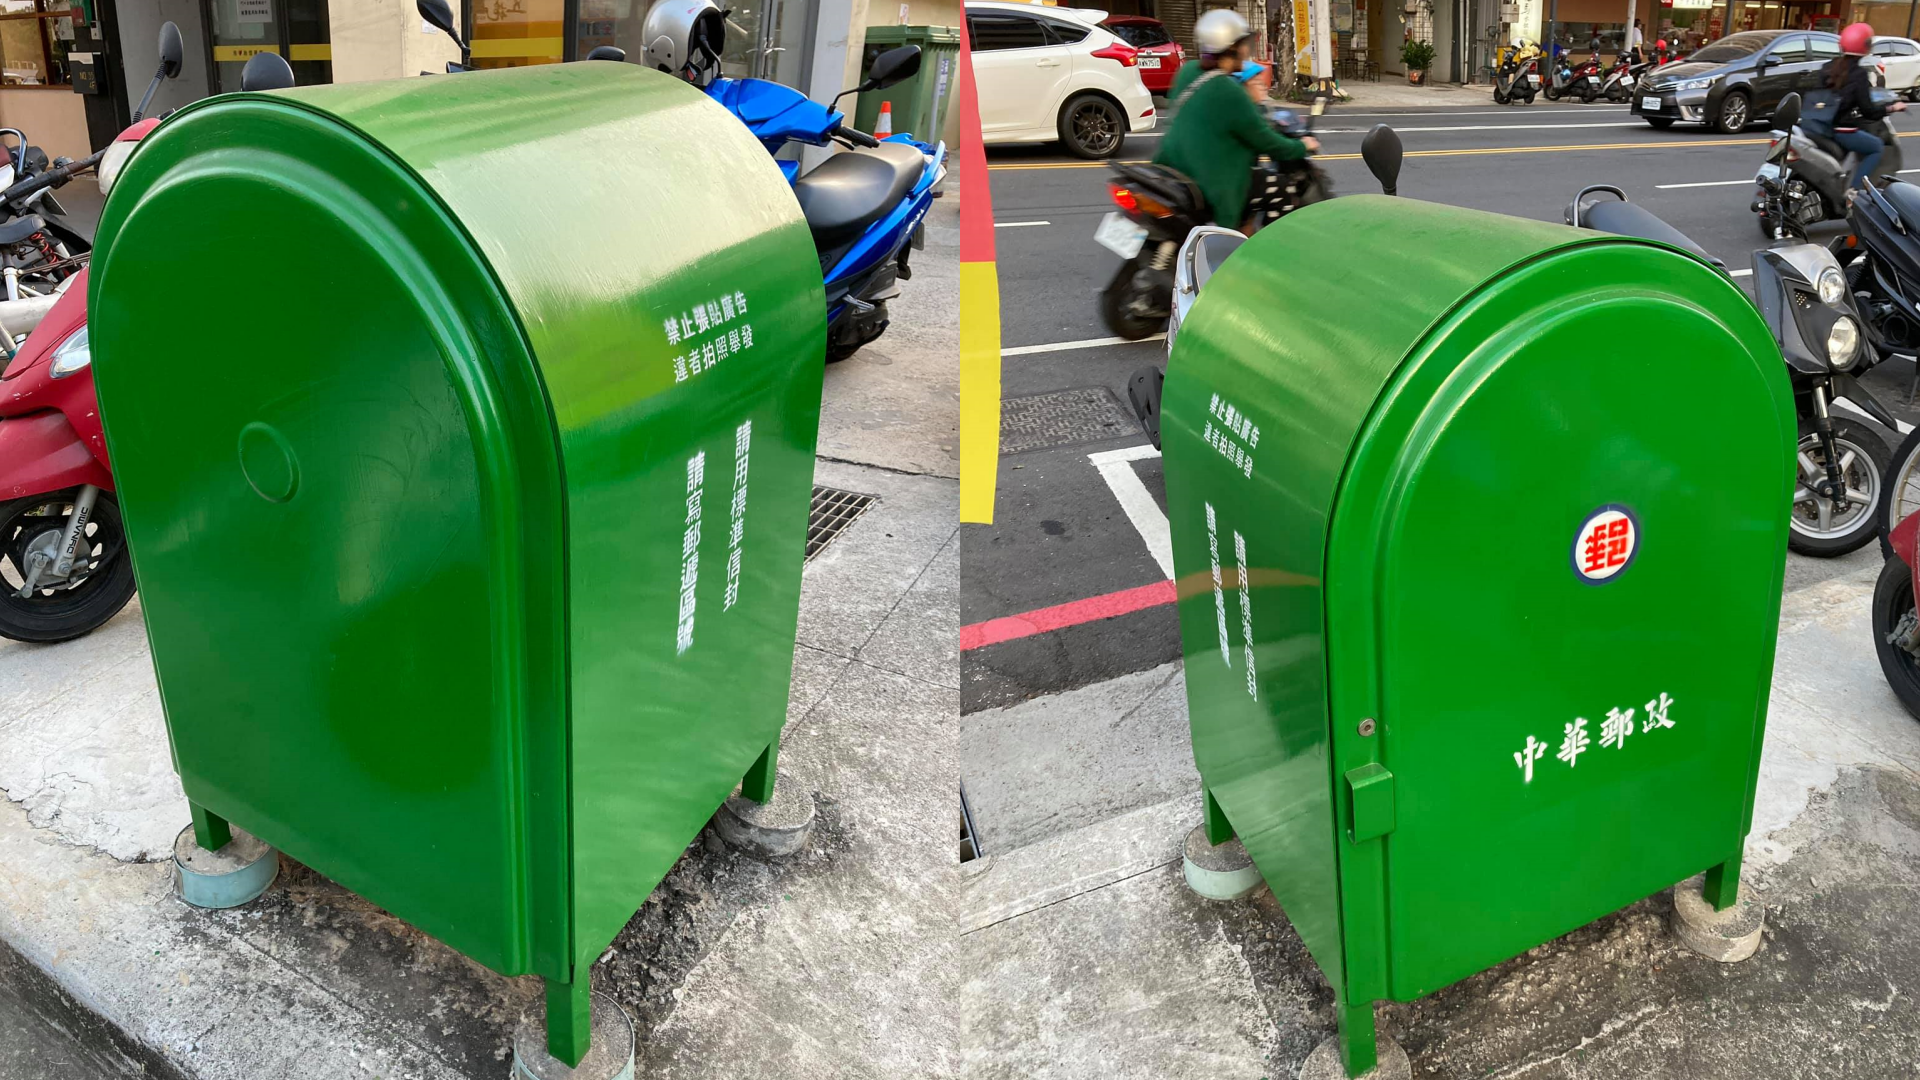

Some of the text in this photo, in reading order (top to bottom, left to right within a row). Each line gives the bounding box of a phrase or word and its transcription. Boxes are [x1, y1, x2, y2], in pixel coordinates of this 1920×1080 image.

[663, 290, 748, 346] 禁止張貼廣告
[672, 323, 754, 384] 違者拍照舉發
[1208, 392, 1260, 450] 禁止張貼廣告
[67, 507, 89, 553] DYNAMIC
[723, 419, 752, 613] 請用標準信封
[1583, 517, 1630, 574] 郵
[676, 450, 706, 656] 請寫郵遞區號
[1512, 691, 1677, 784] 中華郵政
